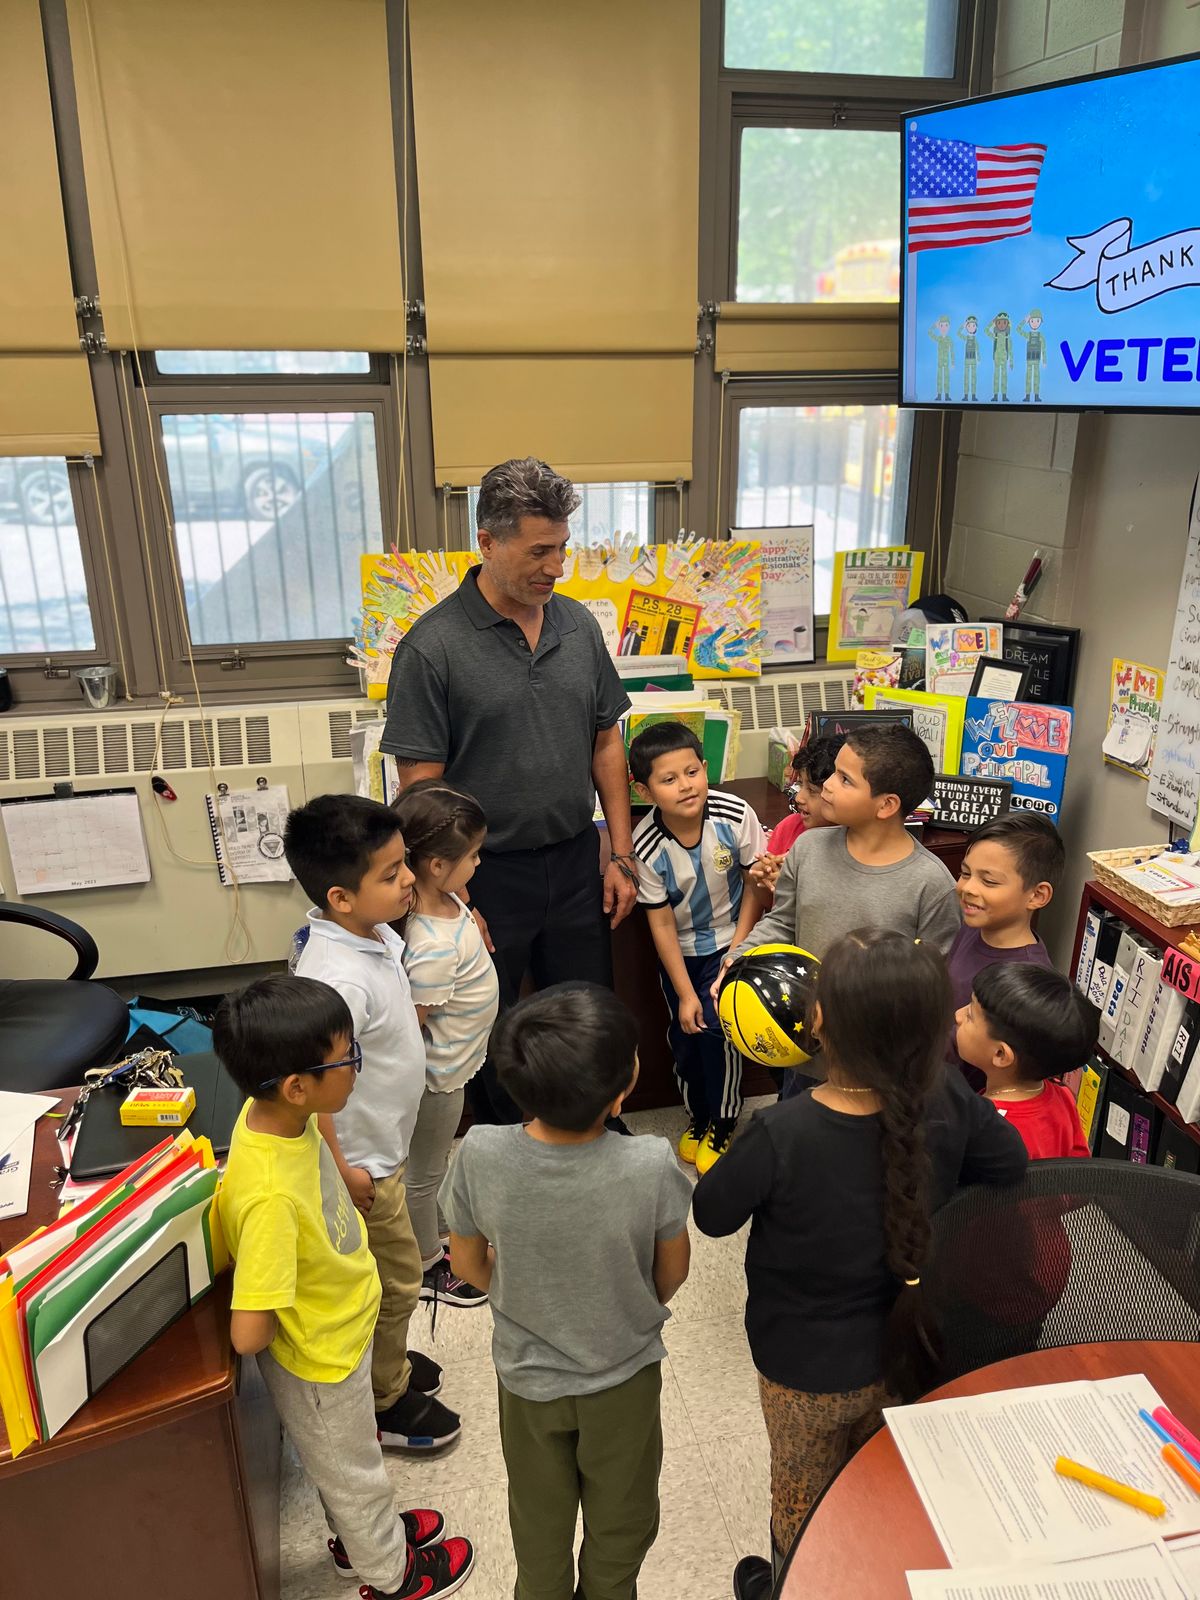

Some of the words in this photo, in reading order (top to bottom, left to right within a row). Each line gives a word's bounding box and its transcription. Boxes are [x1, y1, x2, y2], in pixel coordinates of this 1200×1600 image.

[1105, 244, 1194, 296] THANK
[1060, 336, 1200, 382] VETE
[760, 546, 787, 556] appy
[642, 597, 662, 611] P.S.
[666, 603, 682, 616] 28
[1004, 648, 1049, 665] DREAM
[1116, 667, 1132, 687] WE
[964, 702, 1009, 742] WE
[933, 790, 986, 803] STUDENT
[990, 796, 1002, 805] IS
[935, 781, 970, 793] BEHIND
[973, 784, 1003, 796] EVERY
[934, 798, 941, 809] A
[949, 800, 1001, 816] GREAT
[933, 809, 996, 826] TEACHE
[1162, 952, 1193, 993] AIS
[1107, 978, 1124, 1017] Data
